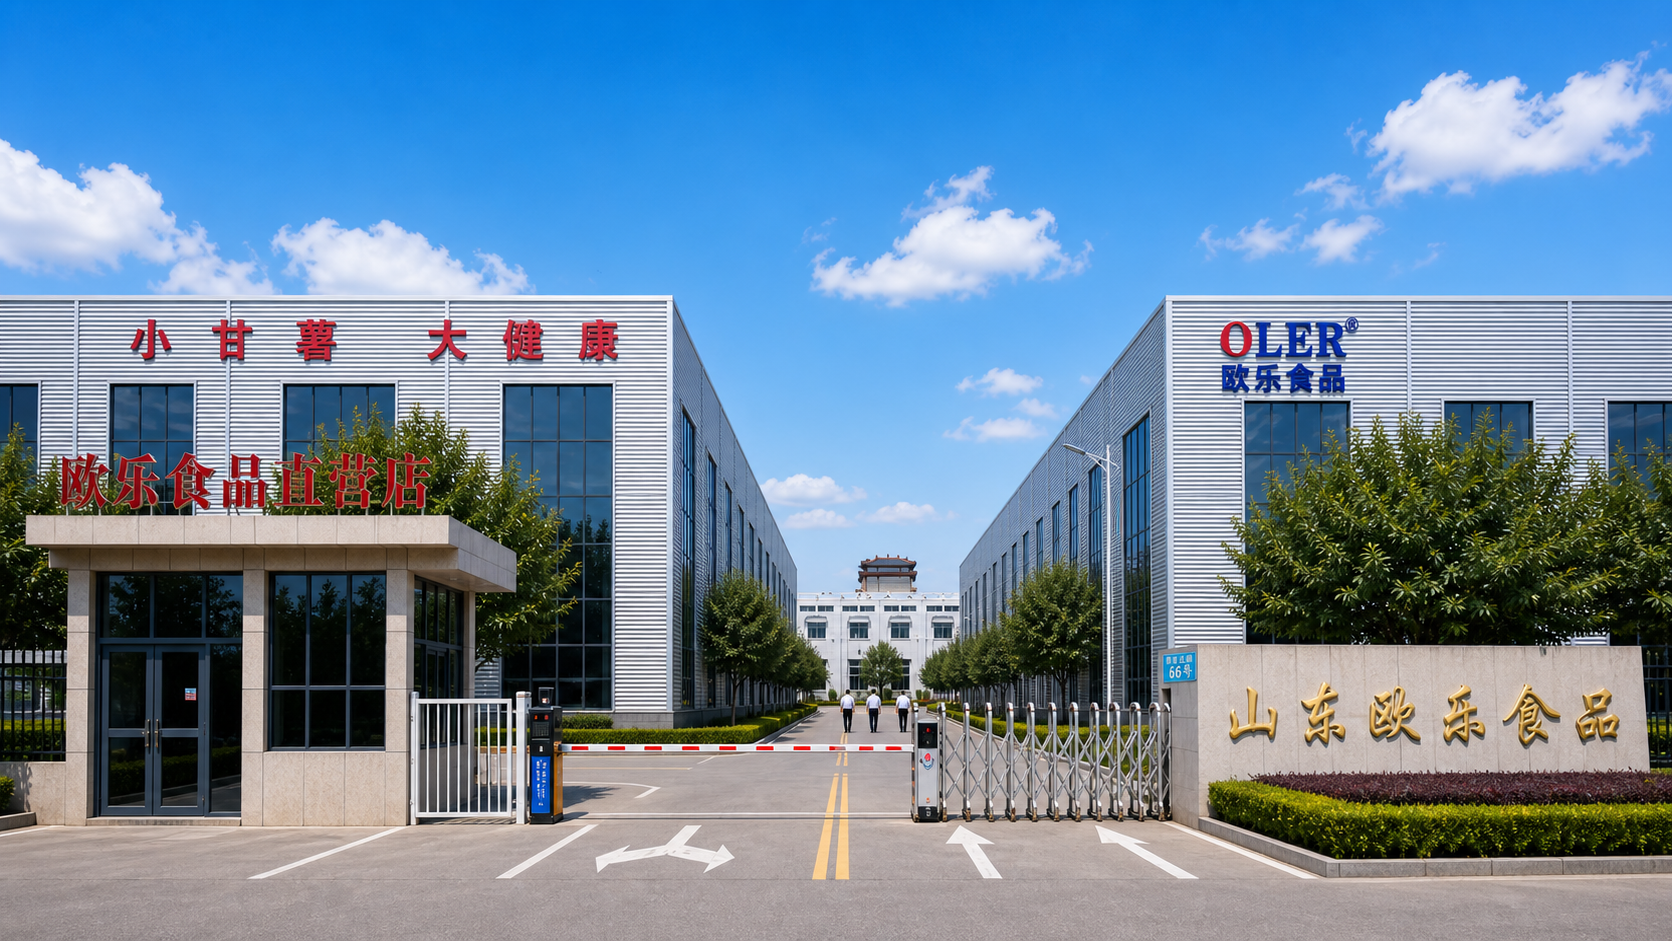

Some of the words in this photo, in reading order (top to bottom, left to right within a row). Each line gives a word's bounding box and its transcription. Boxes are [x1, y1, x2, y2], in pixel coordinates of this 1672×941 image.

[131, 319, 337, 361] 小甘薯
[427, 319, 619, 361] 大健康
[1221, 363, 1346, 394] 欧乐食品
[60, 453, 431, 510] 欧乐食品直营店
[1229, 683, 1620, 745] 山东欧乐食品
